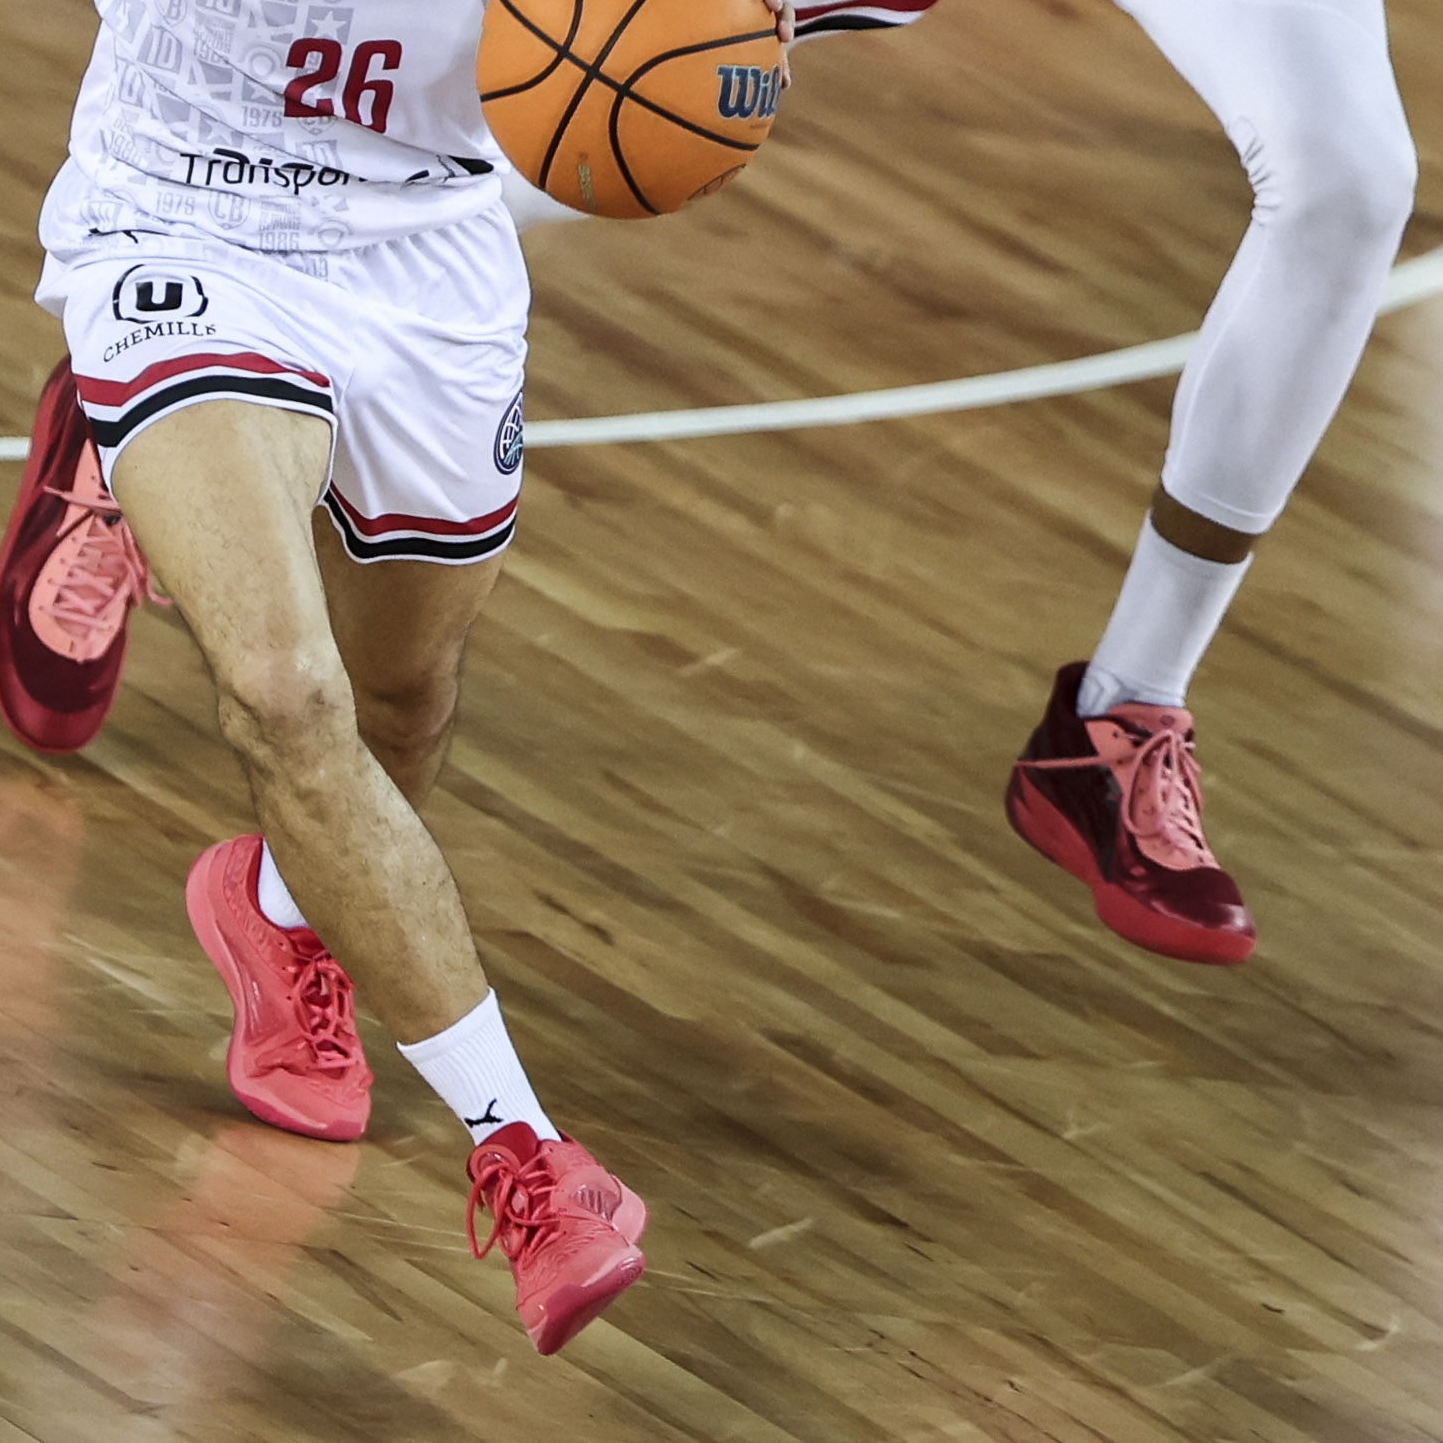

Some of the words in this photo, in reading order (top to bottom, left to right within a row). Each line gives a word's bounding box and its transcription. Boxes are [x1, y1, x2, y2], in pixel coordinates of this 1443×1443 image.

[283, 37, 403, 135] 26
[716, 63, 781, 121] Wil
[180, 147, 368, 196] Transpor
[135, 281, 183, 312] U
